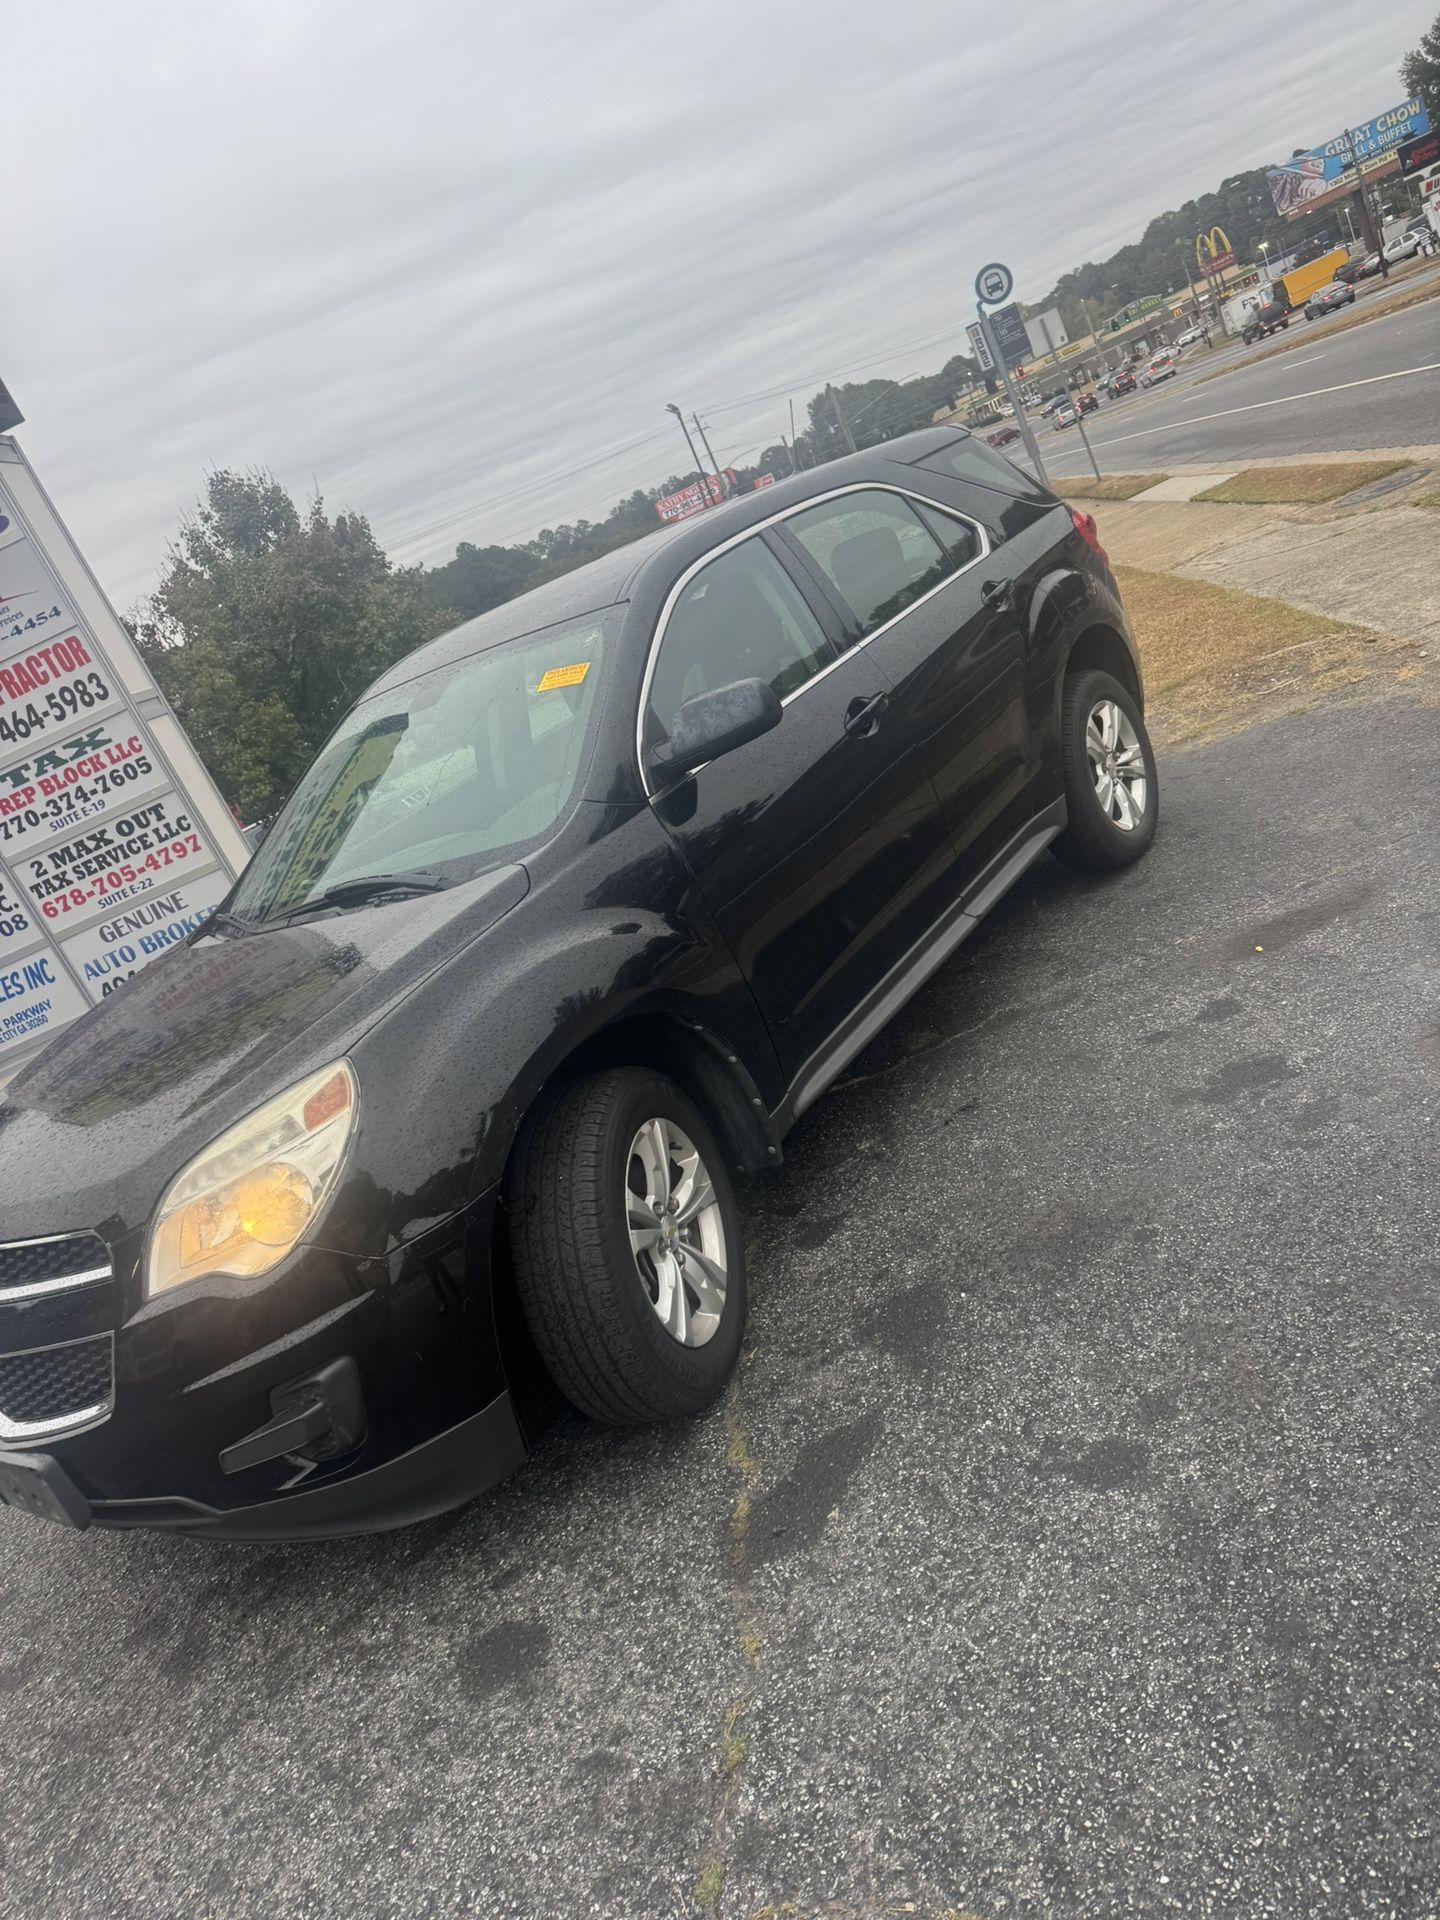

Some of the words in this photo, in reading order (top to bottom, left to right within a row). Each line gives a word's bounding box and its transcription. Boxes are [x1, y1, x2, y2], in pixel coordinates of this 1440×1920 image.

[1376, 100, 1421, 131] CHOW
[1341, 144, 1367, 163] GRLL
[1369, 139, 1376, 150] &
[1378, 120, 1412, 144] BUFFET
[1370, 149, 1382, 158] 300
[1365, 161, 1378, 171] Zion
[1378, 155, 1388, 164] Rd
[975, 336, 992, 368] marta
[657, 494, 685, 512] KATHY
[1, 605, 62, 641] -4454
[0, 672, 110, 743] 464-5983
[0, 727, 112, 790] TAX
[1, 785, 37, 816] REP
[38, 752, 107, 797] BLOCK
[107, 735, 144, 765] LLC
[0, 755, 153, 840] 770-374-7605
[50, 810, 80, 832] SUITE
[81, 799, 106, 820] E-19
[29, 871, 74, 899] TAX
[72, 833, 154, 880] SERVICE
[154, 815, 192, 843] LLC
[30, 859, 48, 878] 2
[48, 825, 115, 871] MAX
[115, 803, 166, 834] OUT
[41, 834, 203, 919] 678-705-4797
[98, 887, 129, 909] SUITE
[130, 877, 155, 898] E-22
[0, 895, 20, 916] C.
[99, 892, 189, 943] GENUINE
[22, 958, 56, 990] INC
[82, 945, 137, 981] AUTO
[3, 999, 52, 1029] PARKWAY
[3, 1027, 18, 1040] CITY
[17, 1024, 28, 1035] GA
